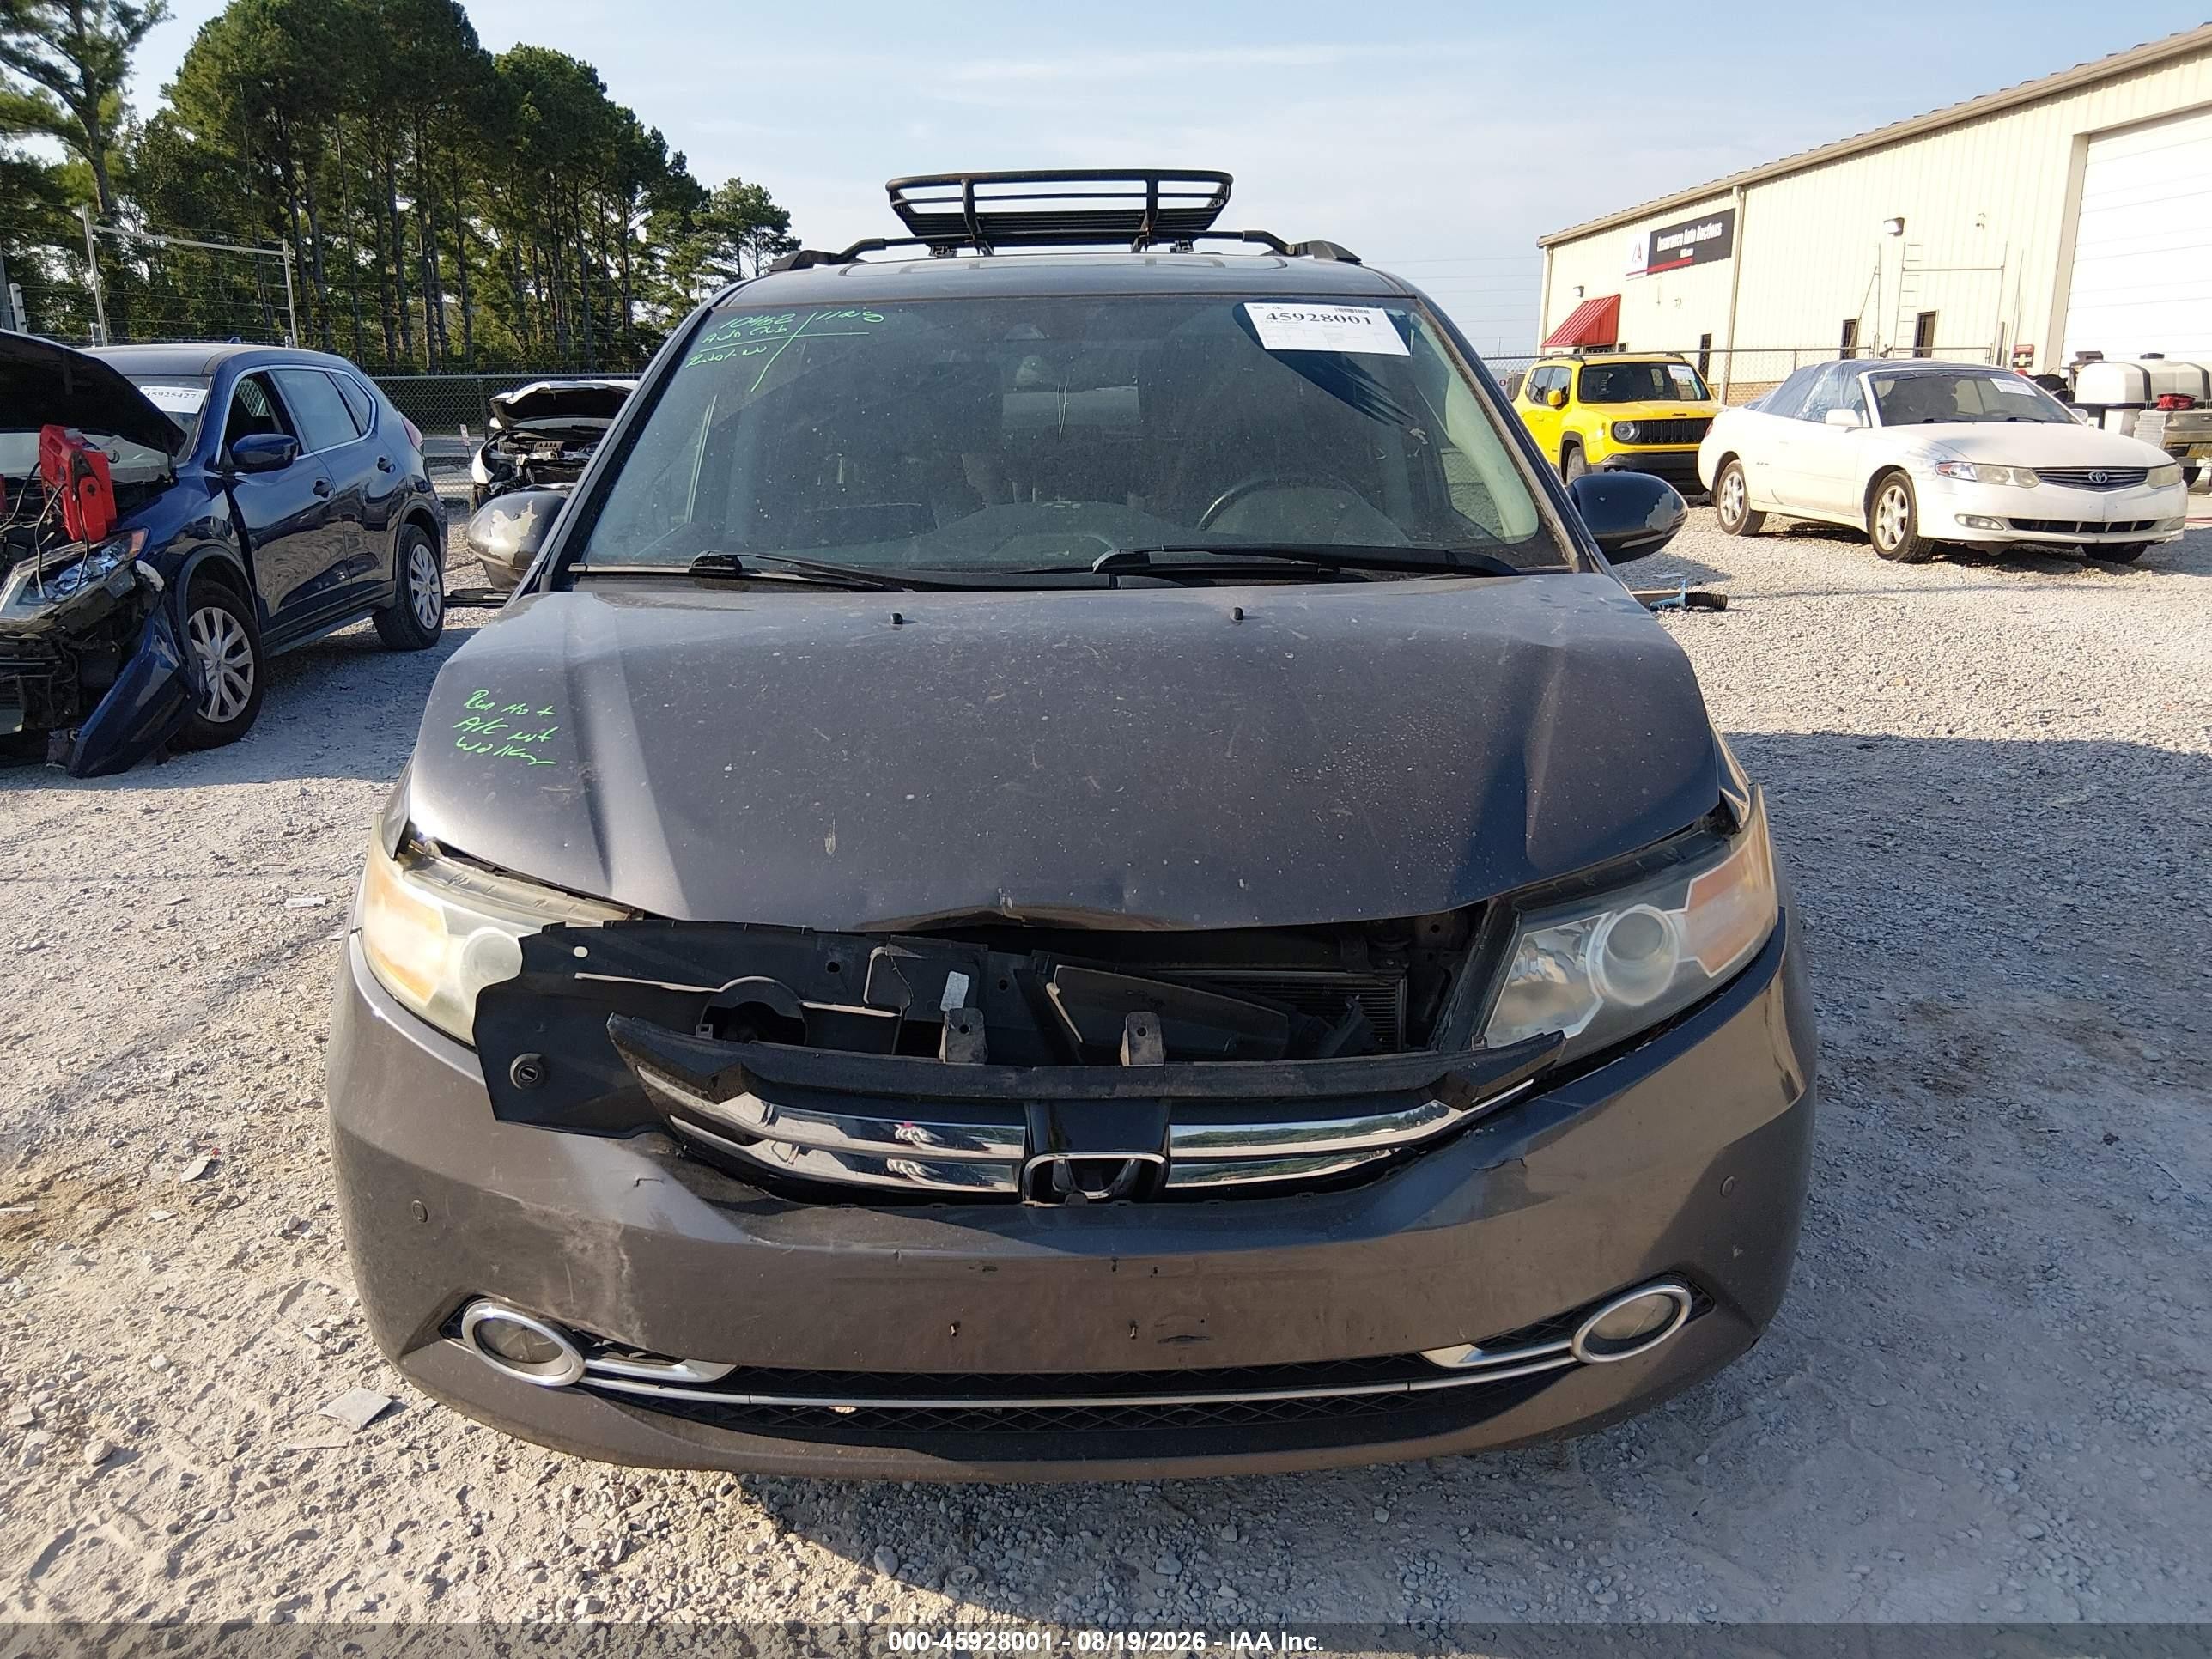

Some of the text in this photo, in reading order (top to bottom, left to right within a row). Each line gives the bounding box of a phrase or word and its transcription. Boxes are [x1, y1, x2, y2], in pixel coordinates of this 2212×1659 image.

[1683, 228, 1697, 245] Auto
[1696, 222, 1723, 241] Auctions
[1266, 312, 1374, 325] 45928001
[453, 717, 509, 735] A/C
